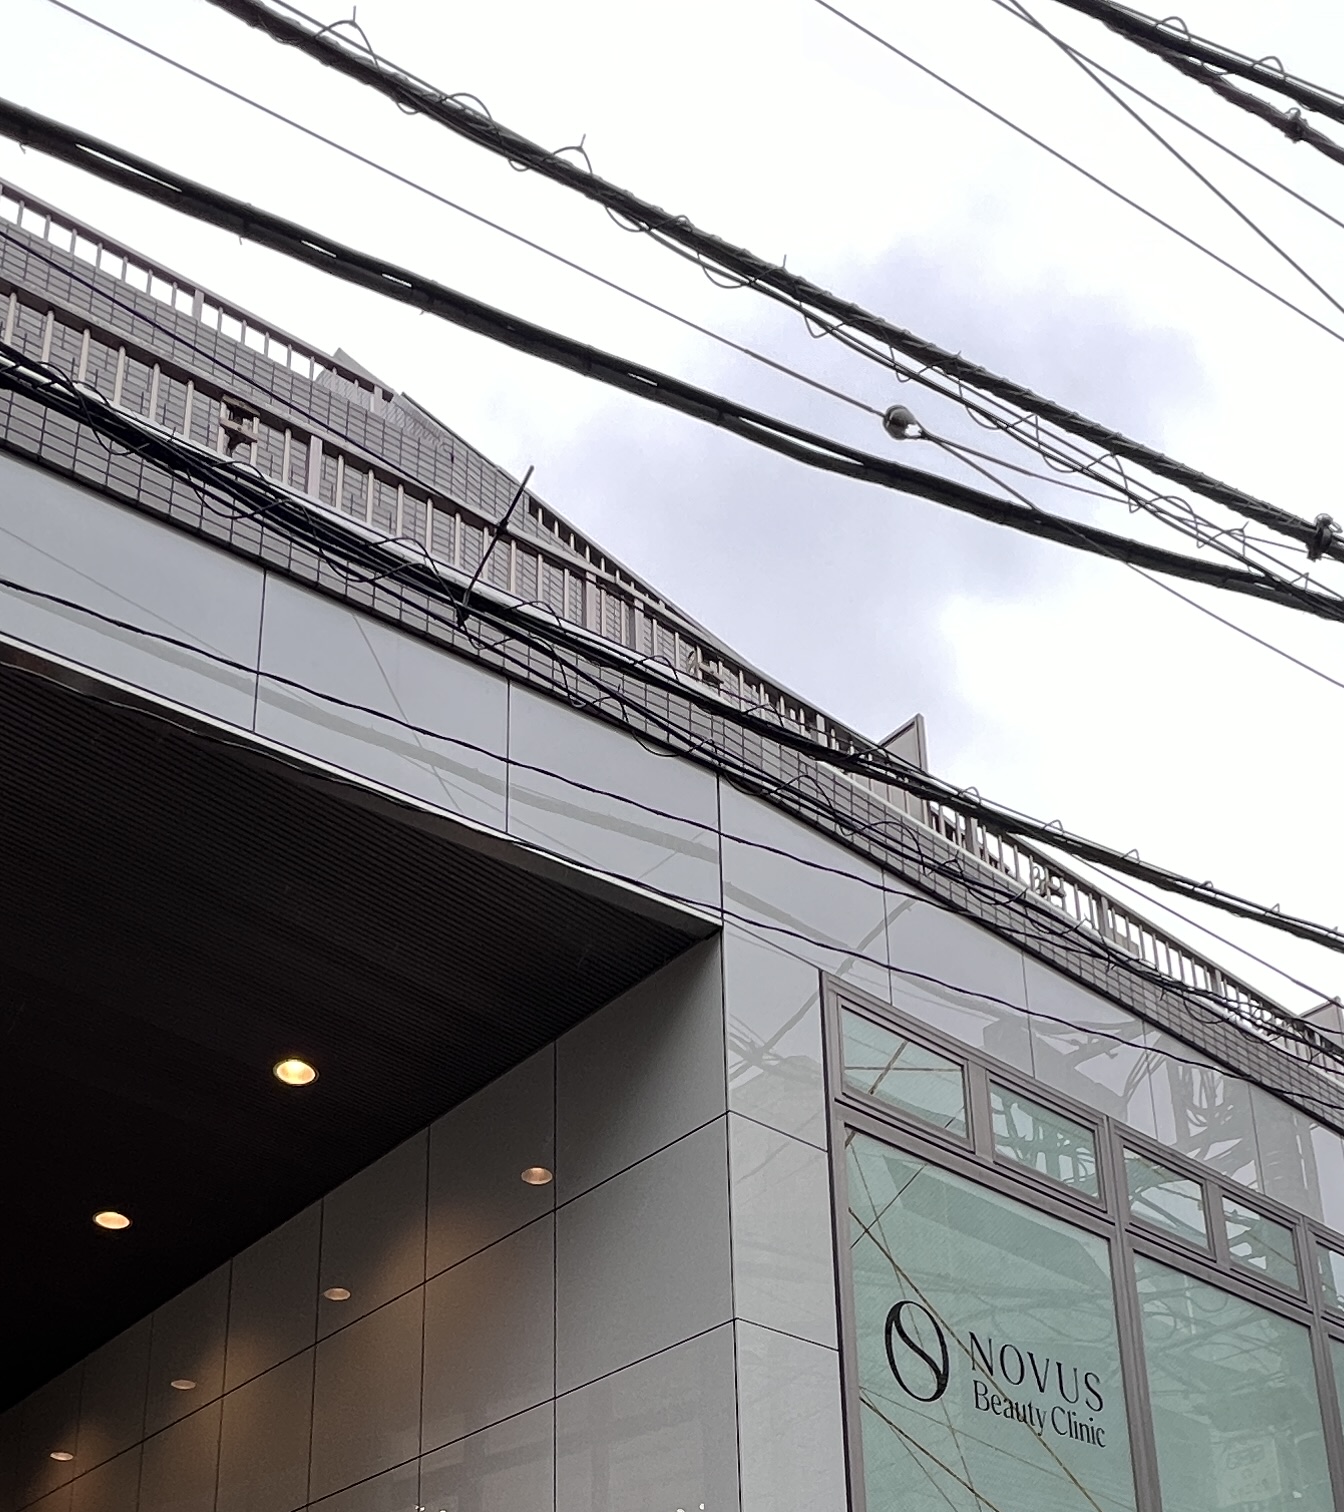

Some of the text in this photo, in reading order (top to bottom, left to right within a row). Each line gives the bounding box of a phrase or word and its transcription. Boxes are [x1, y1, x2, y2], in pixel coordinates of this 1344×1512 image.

[968, 1331, 1104, 1412] NOVUS
[973, 1379, 1107, 1448] Beauty Clinic
